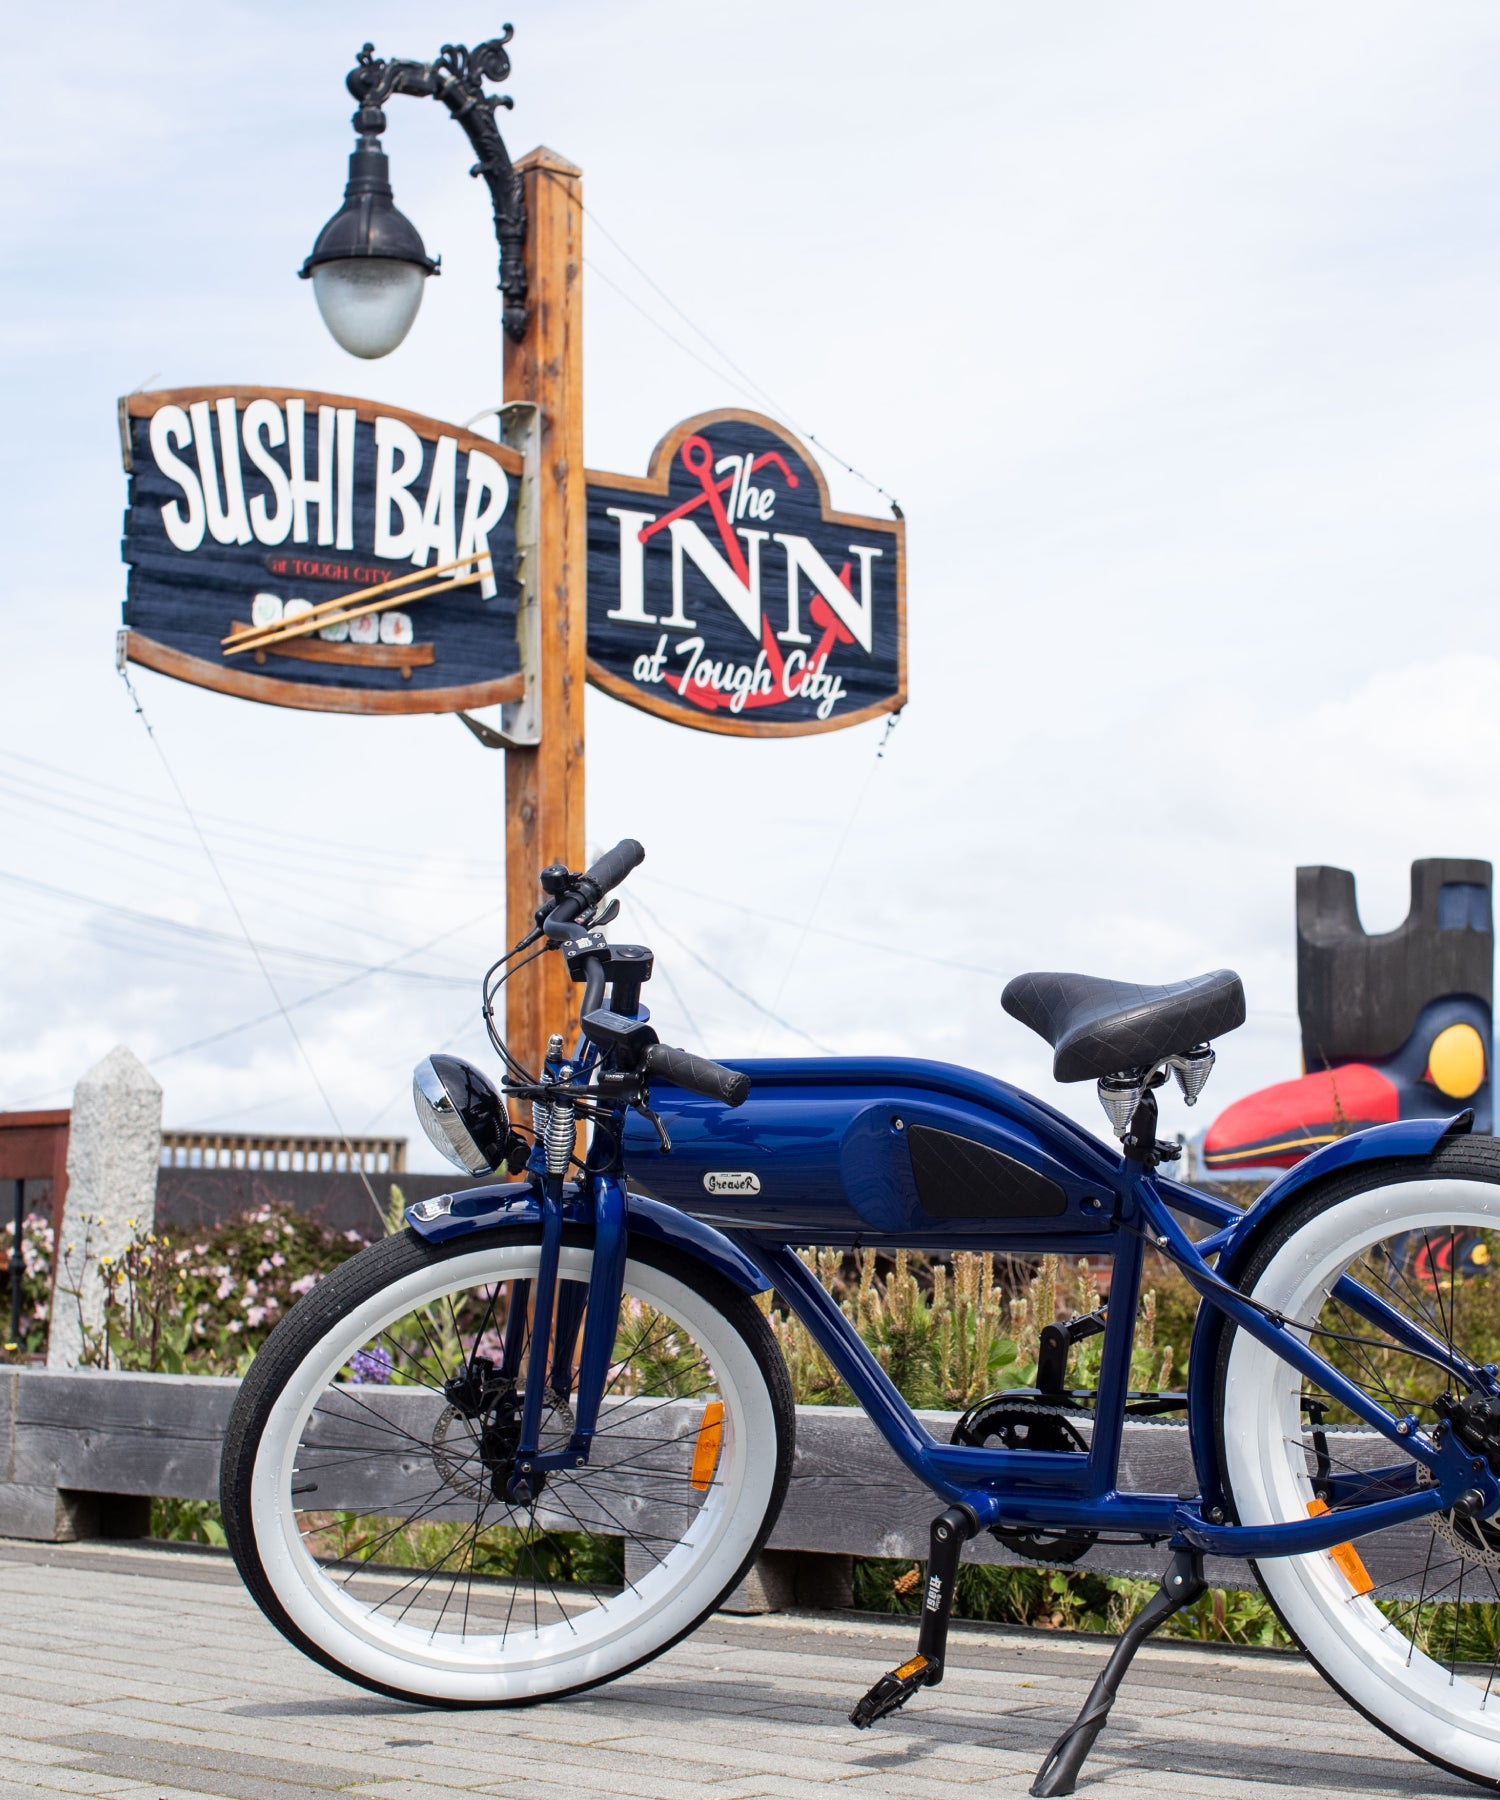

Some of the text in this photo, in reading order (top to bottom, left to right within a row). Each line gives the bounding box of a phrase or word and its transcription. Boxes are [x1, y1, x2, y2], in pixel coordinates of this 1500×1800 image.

[149, 397, 509, 600] SUSHI BAR
[714, 452, 776, 525] The
[271, 558, 393, 584] at TOUGH CITY
[605, 506, 883, 654] INN
[632, 633, 847, 720] at Tough City
